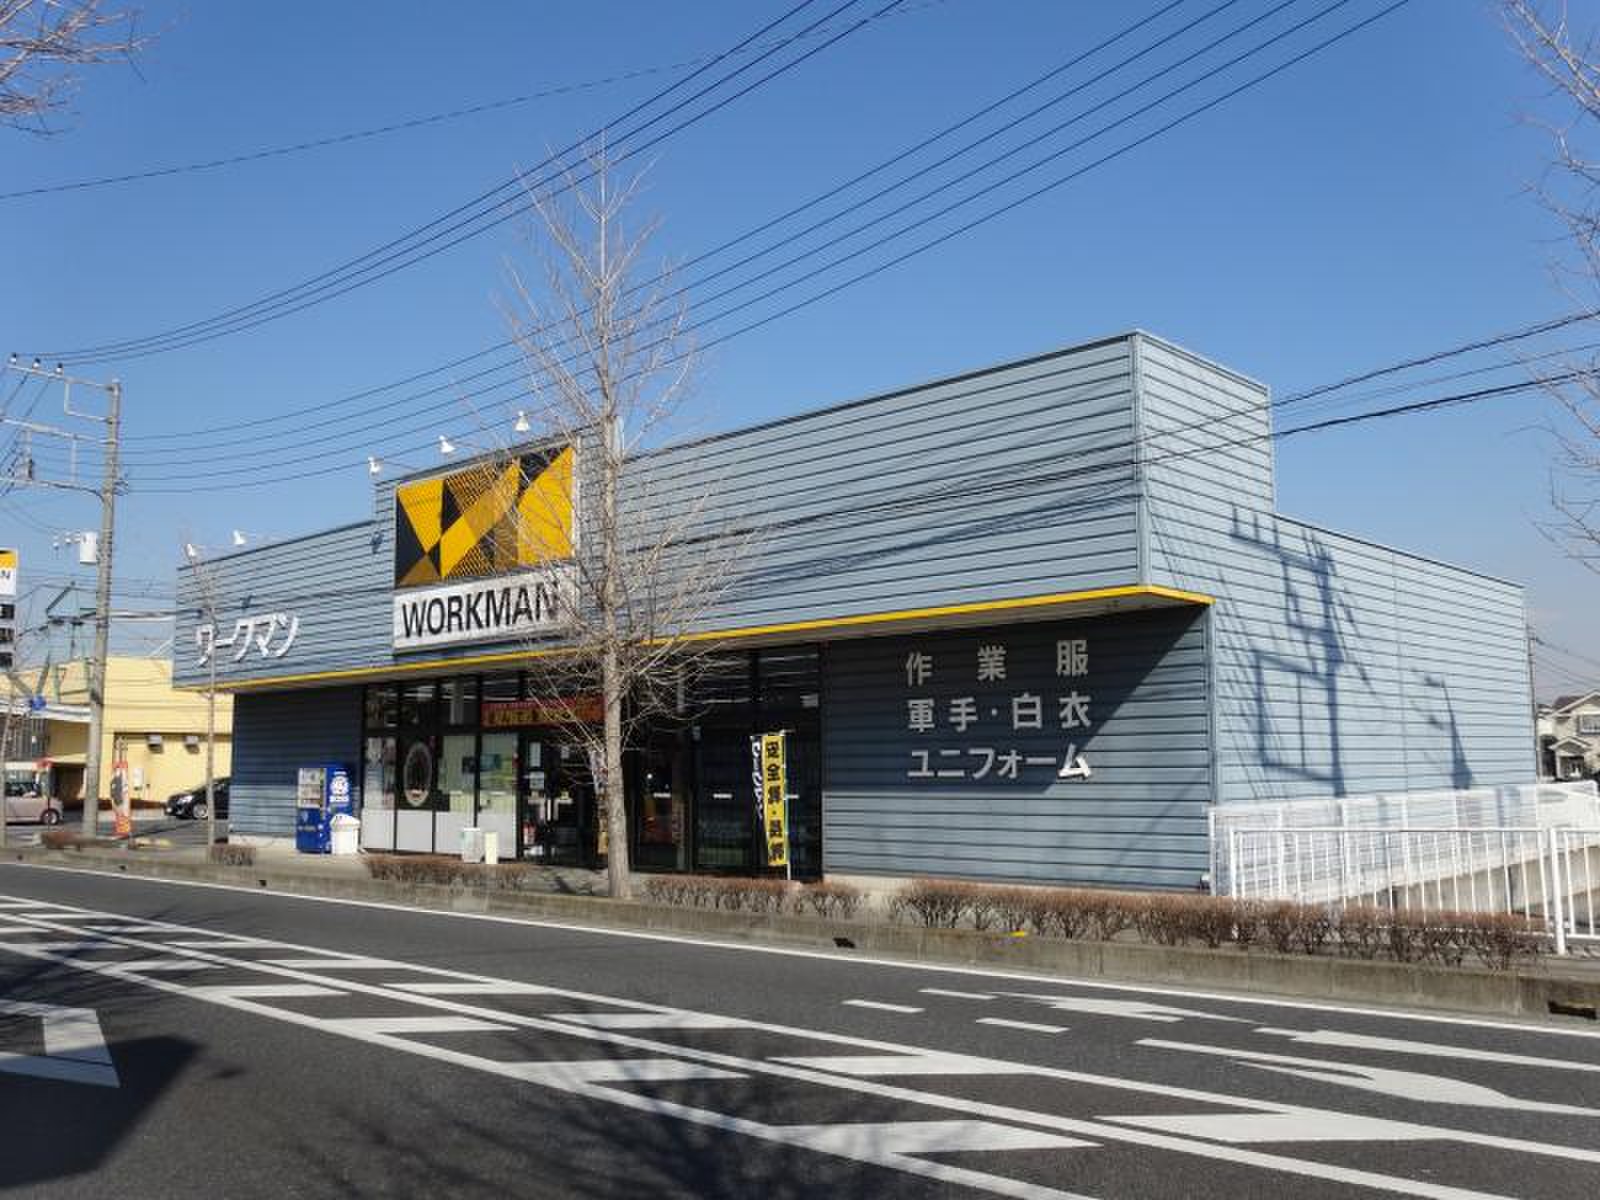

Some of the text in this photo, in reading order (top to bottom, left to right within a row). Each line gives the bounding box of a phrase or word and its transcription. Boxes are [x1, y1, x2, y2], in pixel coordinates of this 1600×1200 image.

[402, 582, 558, 638] WORKMAN
[194, 612, 299, 666] ワークマン
[906, 640, 1089, 687] 作業服
[907, 743, 1092, 781] ユニフォーム
